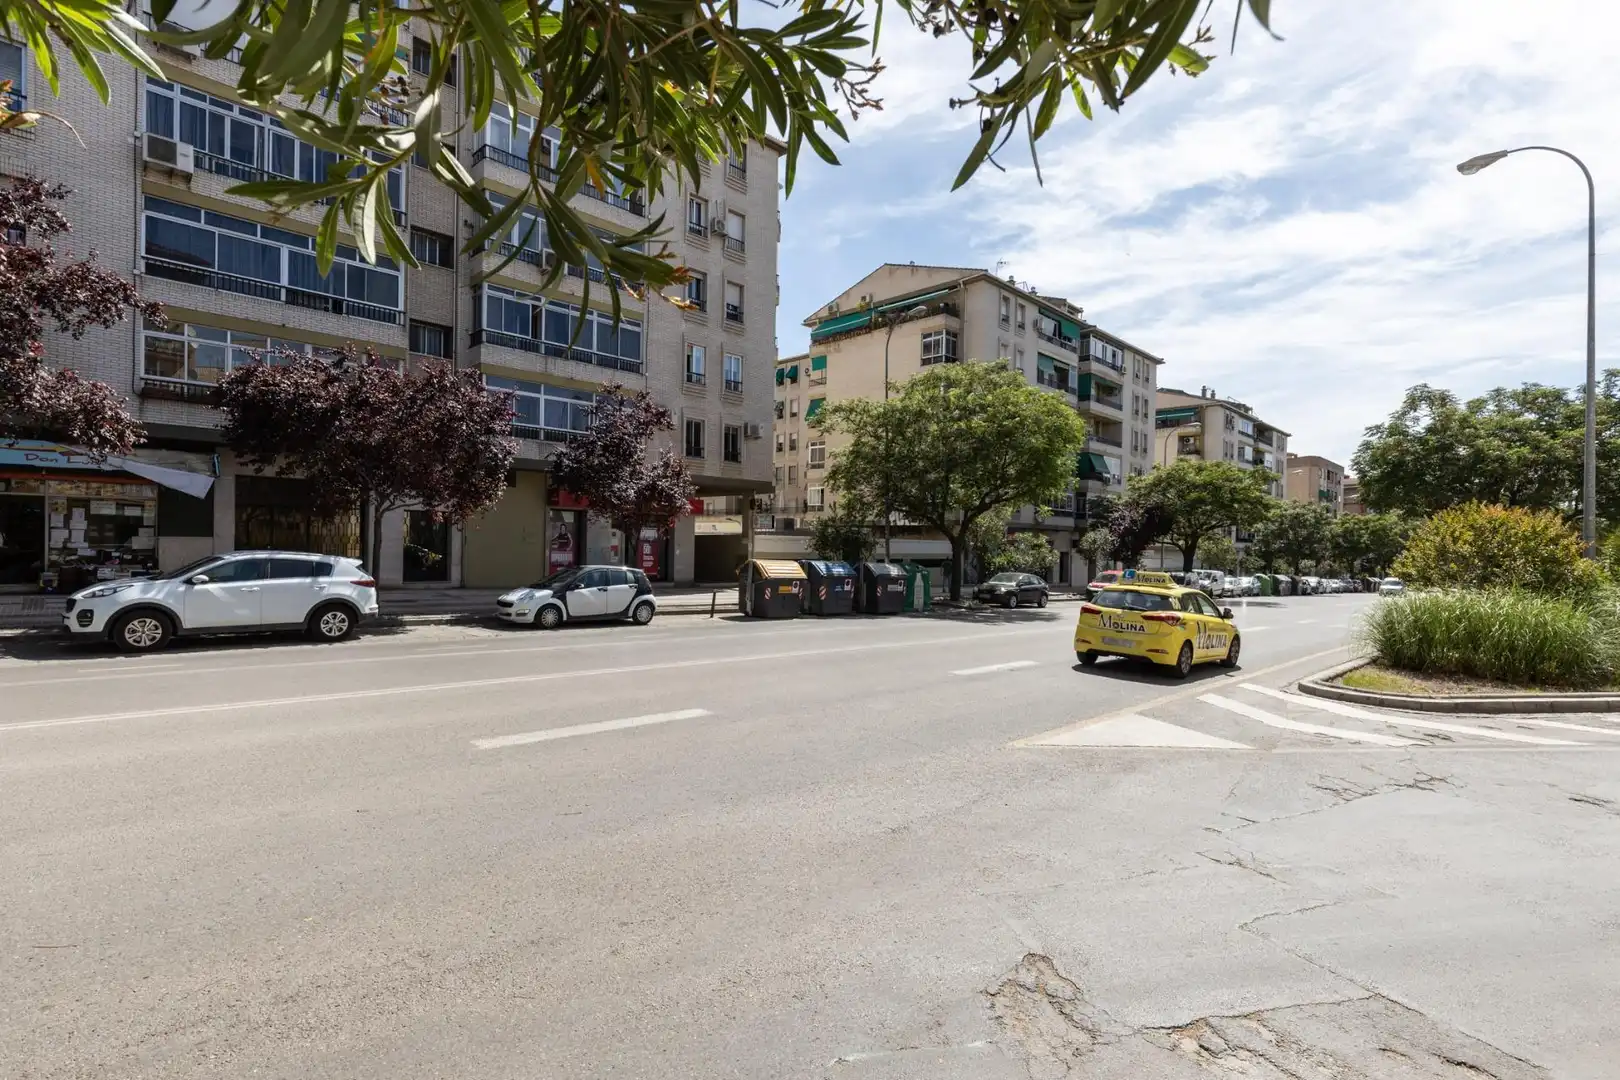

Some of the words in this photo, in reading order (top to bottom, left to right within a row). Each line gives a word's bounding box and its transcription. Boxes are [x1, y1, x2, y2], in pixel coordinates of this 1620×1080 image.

[24, 453, 58, 463] Don
[1136, 574, 1166, 583] MOLINA
[1098, 614, 1146, 633] MOLINA
[1196, 621, 1228, 650] MOLINA
